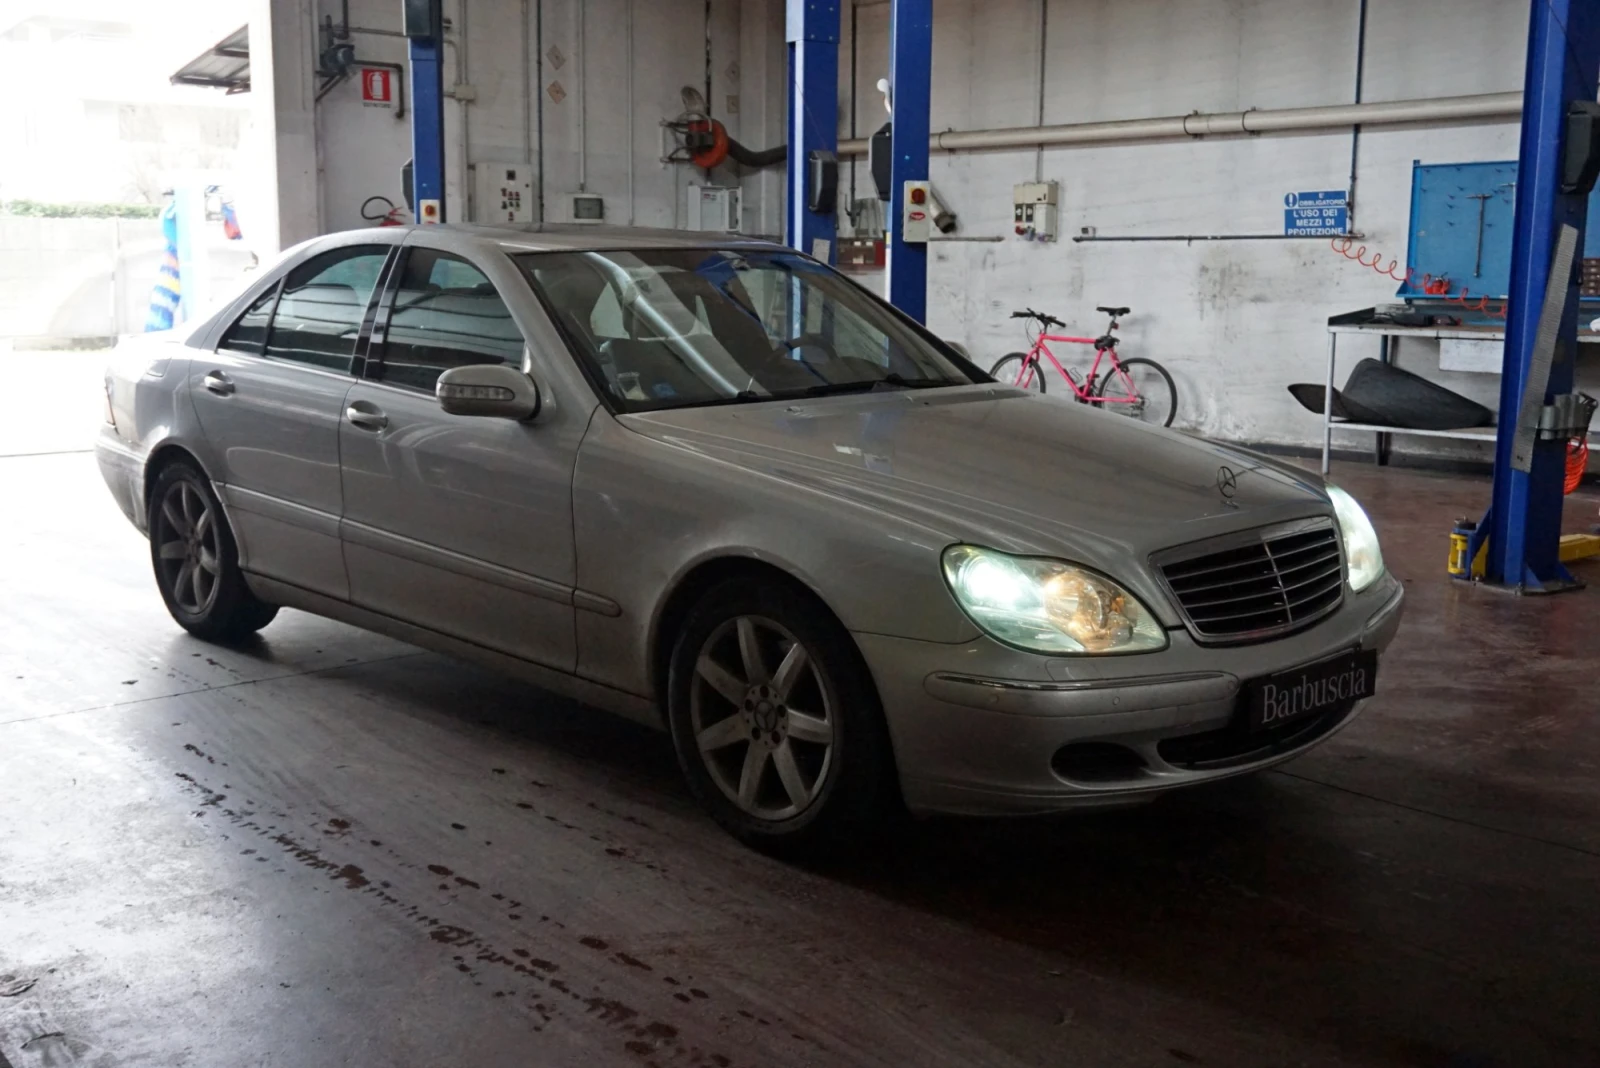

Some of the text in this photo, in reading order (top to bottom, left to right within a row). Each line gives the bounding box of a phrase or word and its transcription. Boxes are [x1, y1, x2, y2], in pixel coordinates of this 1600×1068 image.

[1293, 208, 1338, 218] L'USO DEI
[1296, 218, 1335, 227] MEZZI DI
[1287, 228, 1344, 236] PROTEZIONE
[1262, 662, 1366, 723] Barbuscia
